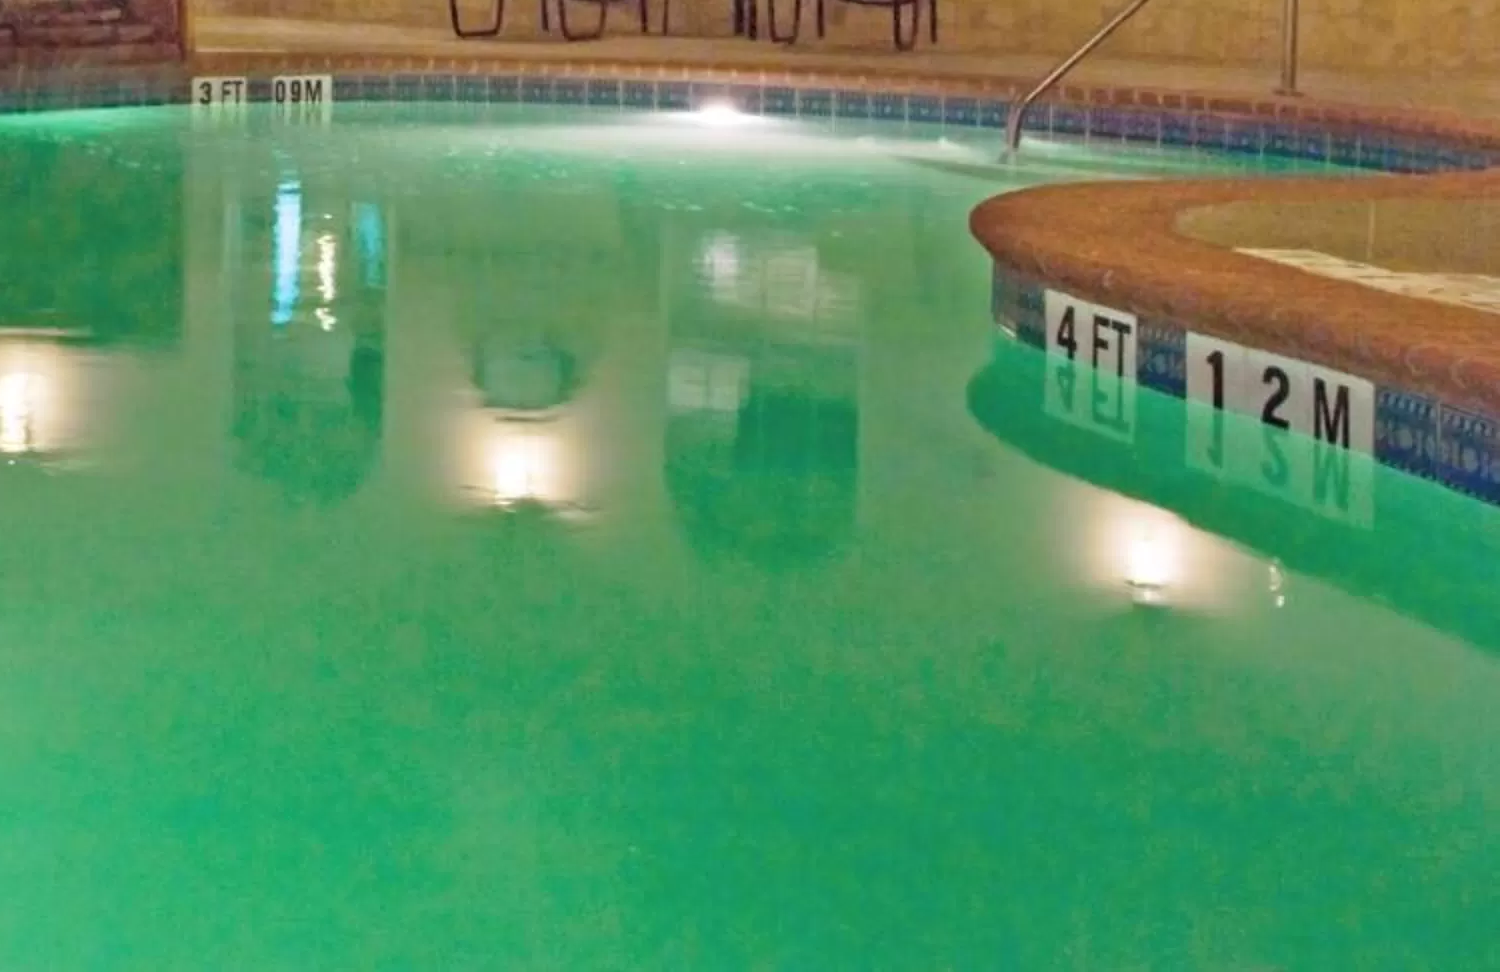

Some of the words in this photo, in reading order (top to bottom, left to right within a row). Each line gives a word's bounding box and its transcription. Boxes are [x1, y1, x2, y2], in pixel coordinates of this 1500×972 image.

[199, 81, 212, 105] 3
[221, 80, 244, 104] FT
[1057, 305, 1077, 360] 4
[1093, 314, 1131, 377] FT
